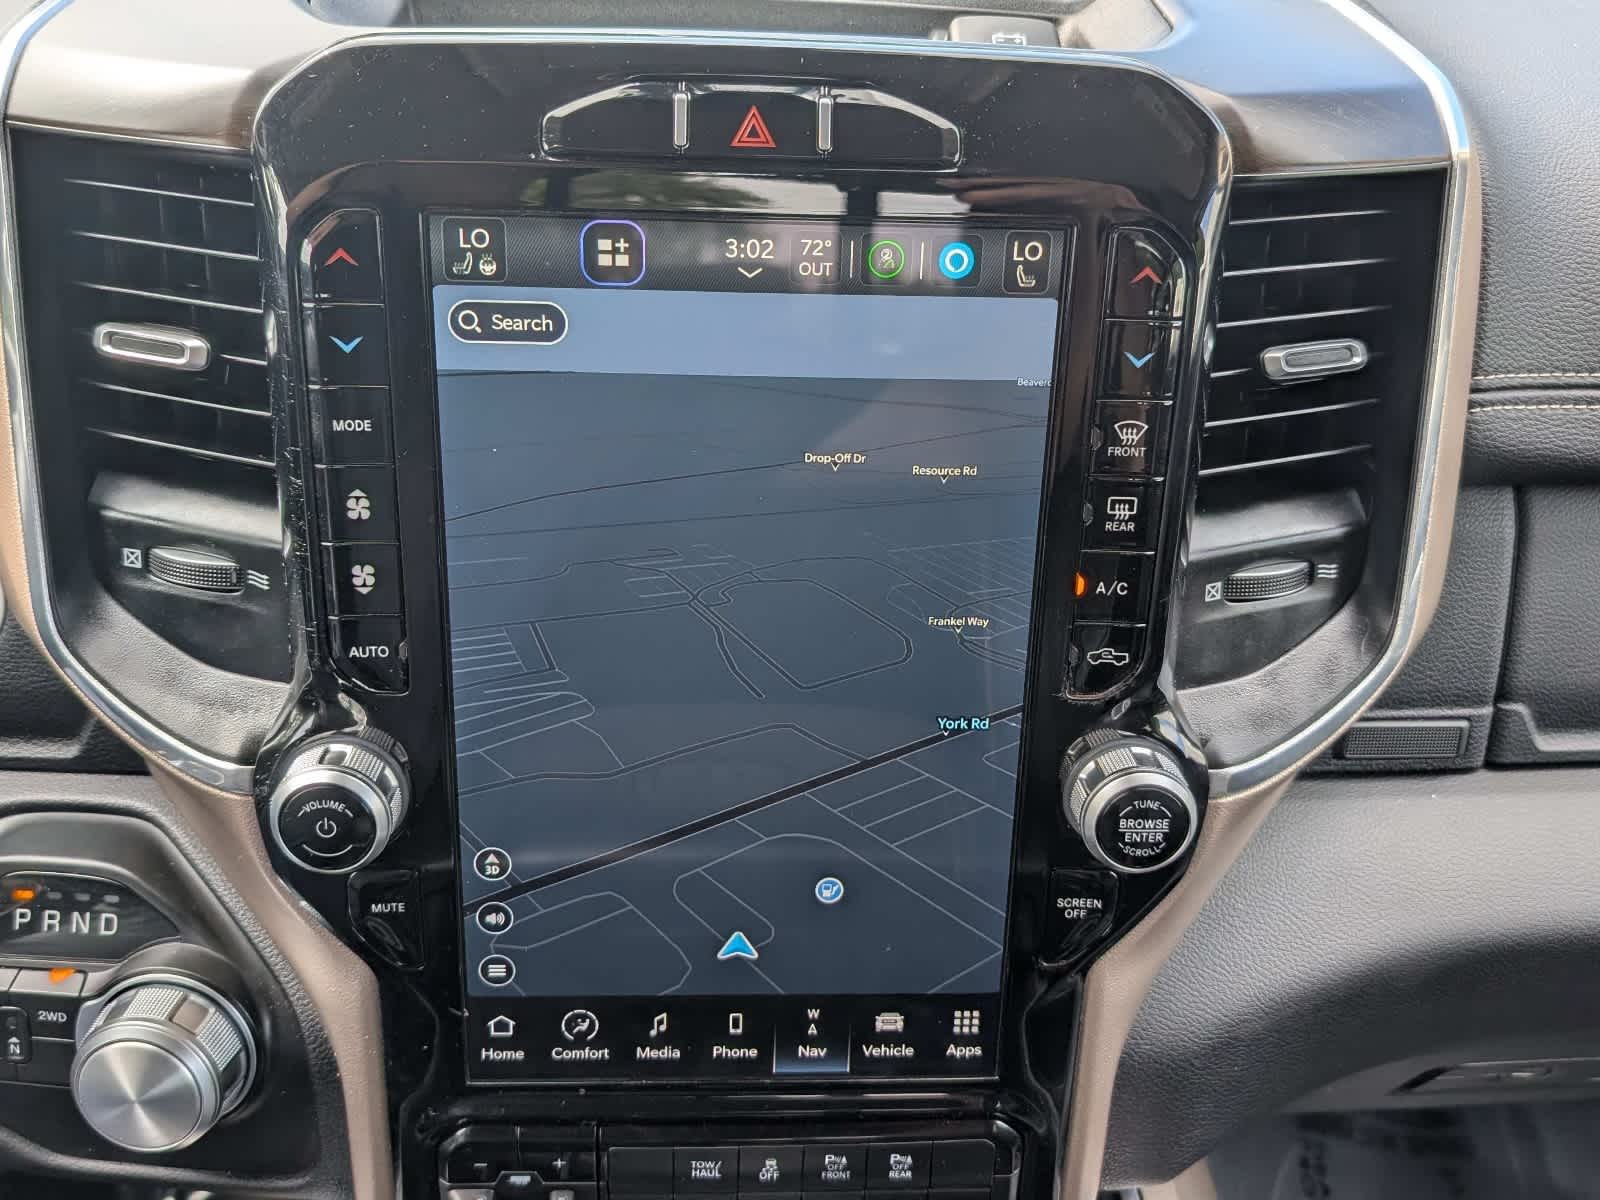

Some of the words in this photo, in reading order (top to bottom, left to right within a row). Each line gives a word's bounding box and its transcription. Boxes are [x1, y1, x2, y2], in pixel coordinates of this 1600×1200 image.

[458, 227, 491, 249] LO
[723, 238, 776, 260] 3:02
[1012, 241, 1044, 262] LO
[798, 261, 833, 278] OUT
[491, 313, 553, 333] Search
[332, 418, 373, 433] MODE
[804, 452, 852, 465] Drop-Off
[853, 453, 867, 465] Dr
[1107, 446, 1146, 458] FRONT
[912, 465, 961, 477] Resource
[962, 466, 977, 477] Rd
[1104, 521, 1136, 533] REAR
[1095, 580, 1129, 596] A/C
[928, 616, 966, 627] Frankel
[967, 616, 989, 629] Way
[348, 645, 390, 659] AUTO
[937, 717, 969, 731] York
[970, 717, 991, 731] Rd
[302, 799, 347, 813] VOLUME
[1133, 799, 1162, 811] TUNE
[1119, 818, 1171, 830] BROWSE
[1124, 832, 1165, 844] ENTER
[1122, 845, 1162, 858] SCROLL
[484, 864, 501, 877] 3D
[370, 902, 407, 914] MUTE
[1056, 897, 1103, 910] SCREEN
[1064, 908, 1089, 920] OFF
[13, 908, 33, 932] P
[42, 909, 61, 934] R
[71, 911, 91, 935] N
[99, 912, 119, 937] D
[37, 1010, 68, 1023] 2WD
[807, 1008, 821, 1020] W
[9, 1043, 21, 1055] N
[480, 1046, 526, 1061] Home
[551, 1045, 611, 1061] Comfort
[636, 1046, 682, 1060] Media
[712, 1045, 759, 1059] Phone
[798, 1044, 828, 1058] Nav
[862, 1043, 915, 1058] Vehicle
[946, 1043, 984, 1059] Apps
[690, 1160, 723, 1169] TOW/
[827, 1163, 844, 1171] OFF
[691, 1168, 722, 1178] HAUL
[759, 1170, 780, 1181] OFF
[821, 1170, 851, 1179] FRONT
[889, 1170, 912, 1178] REAR
